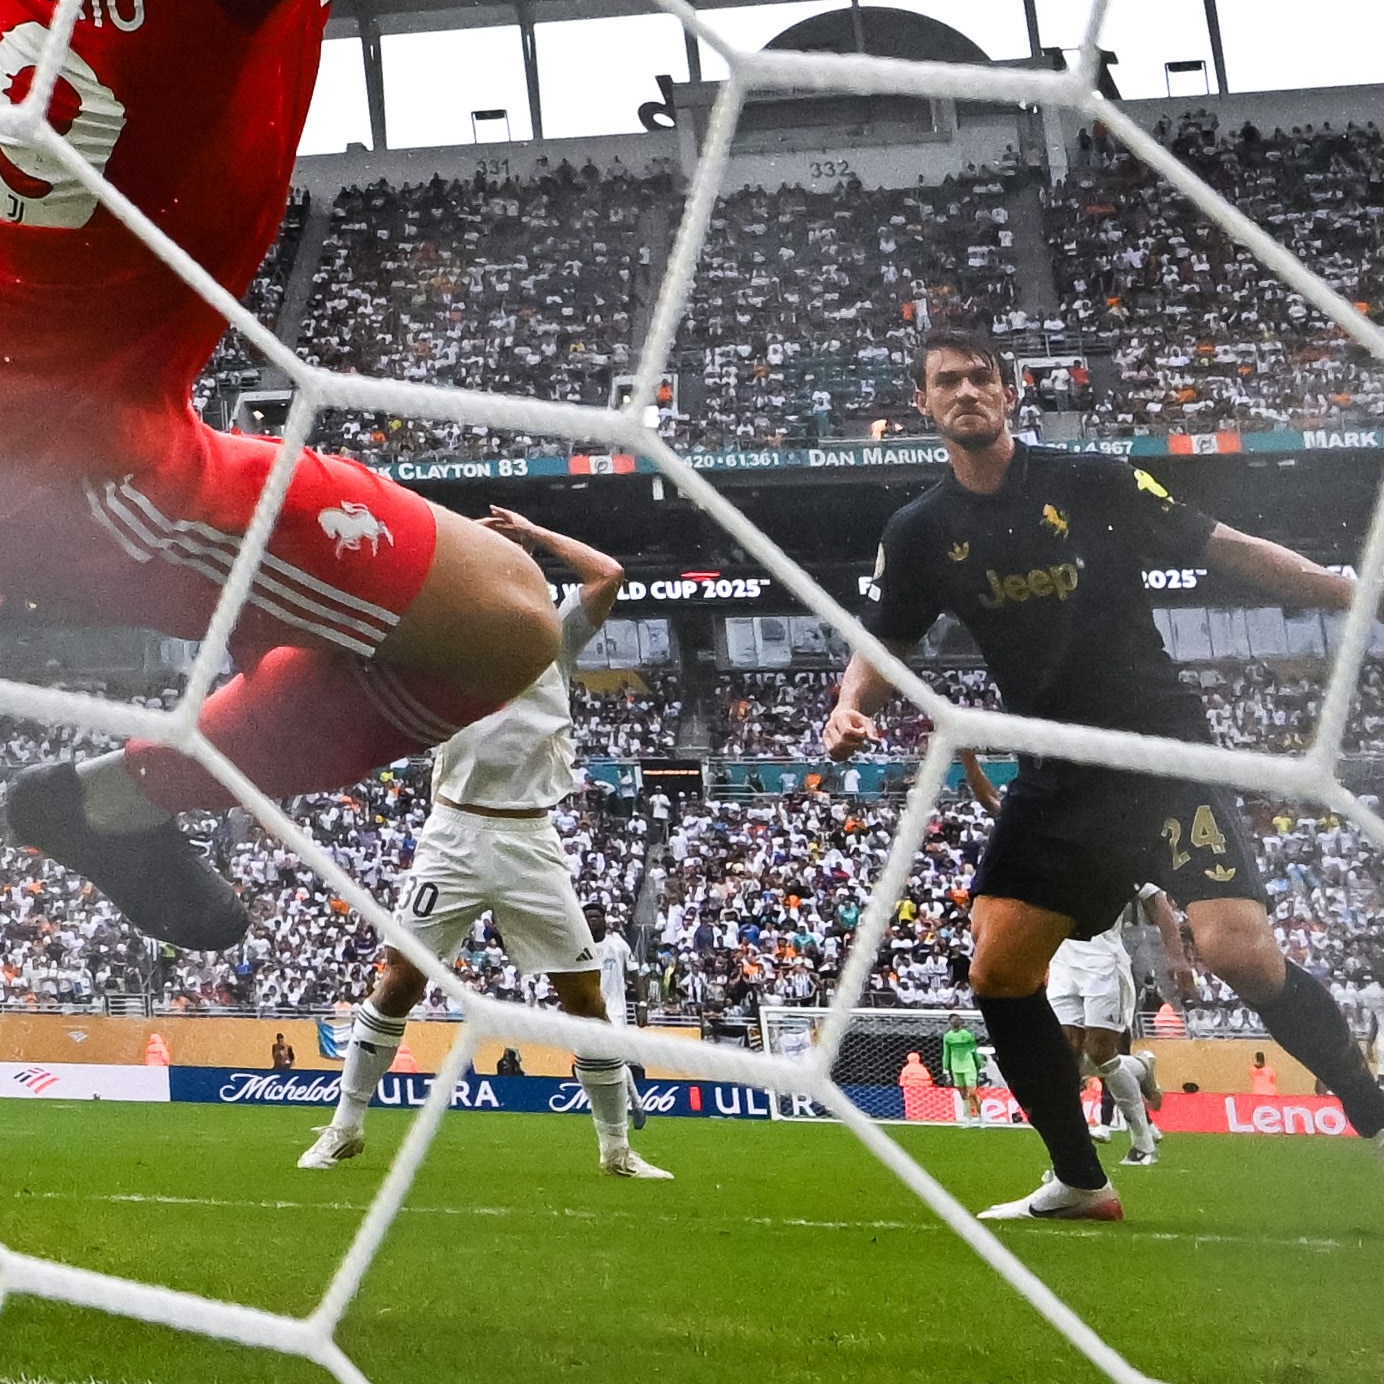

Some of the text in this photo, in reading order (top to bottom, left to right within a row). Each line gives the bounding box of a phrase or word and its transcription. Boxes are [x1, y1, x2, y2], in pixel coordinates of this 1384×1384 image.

[810, 159, 850, 178] 332
[1303, 430, 1379, 449] MARK
[808, 448, 855, 467] DAN
[862, 446, 949, 465] MARINO
[398, 462, 491, 480] CLAYTON
[498, 458, 529, 477] 83
[650, 580, 697, 601] CUP
[978, 563, 1079, 608] Jeep
[1160, 804, 1226, 871] 24
[219, 1072, 341, 1102] Michelob
